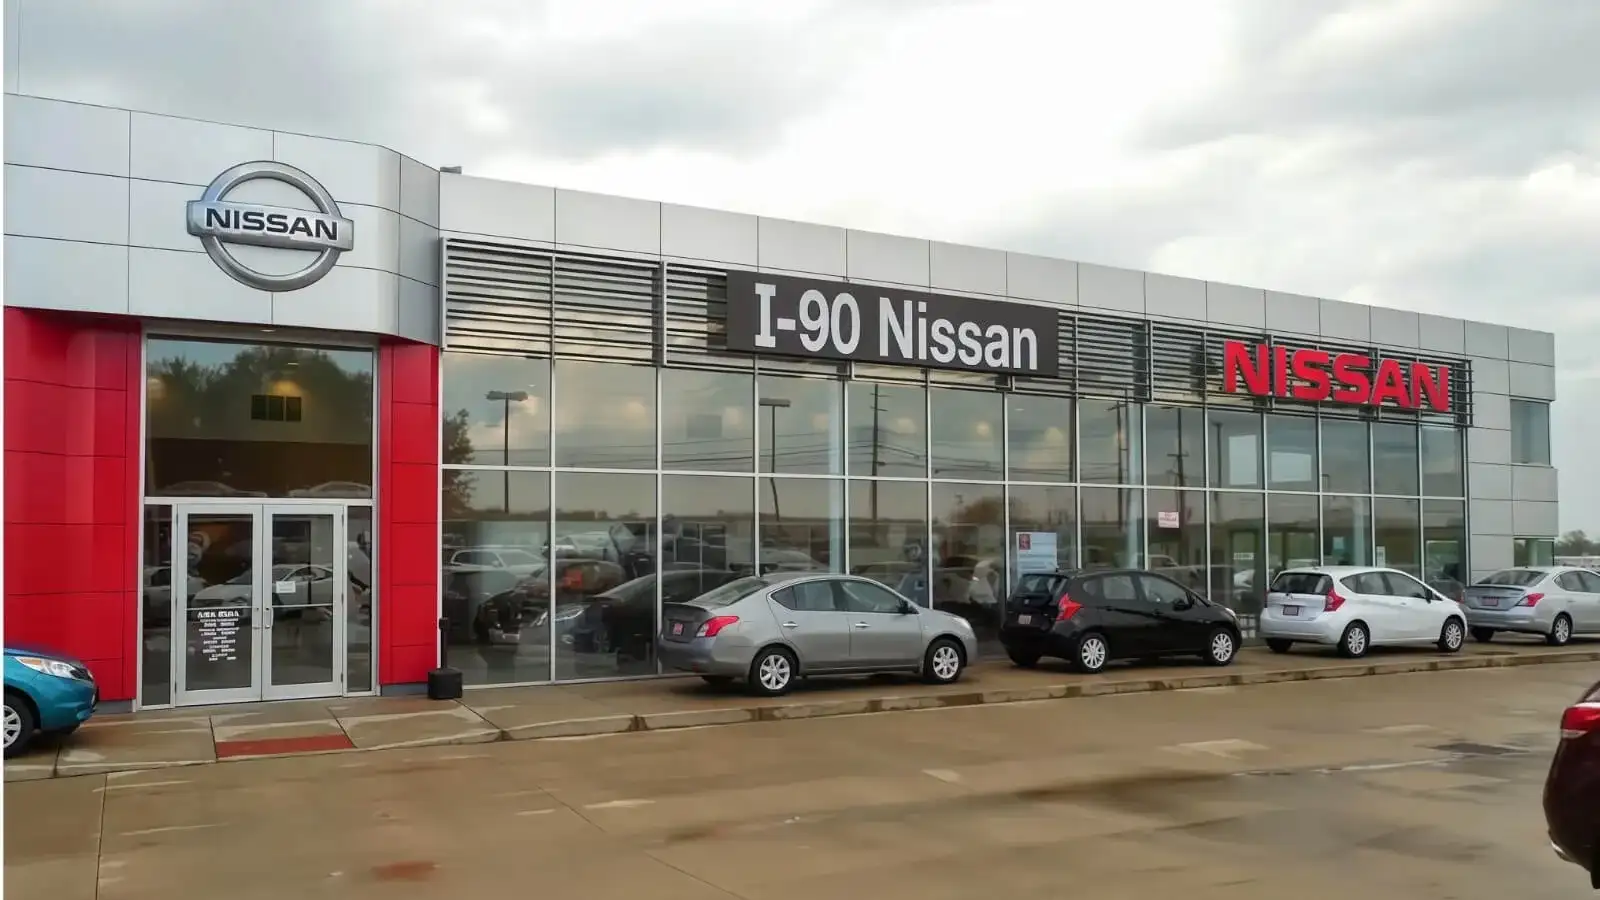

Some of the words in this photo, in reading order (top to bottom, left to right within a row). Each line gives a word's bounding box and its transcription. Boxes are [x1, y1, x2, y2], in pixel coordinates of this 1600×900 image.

[206, 207, 338, 241] NISSAN
[754, 282, 861, 355] I-90
[879, 296, 1038, 371] Nissan
[1223, 338, 1450, 413] NISSAN
